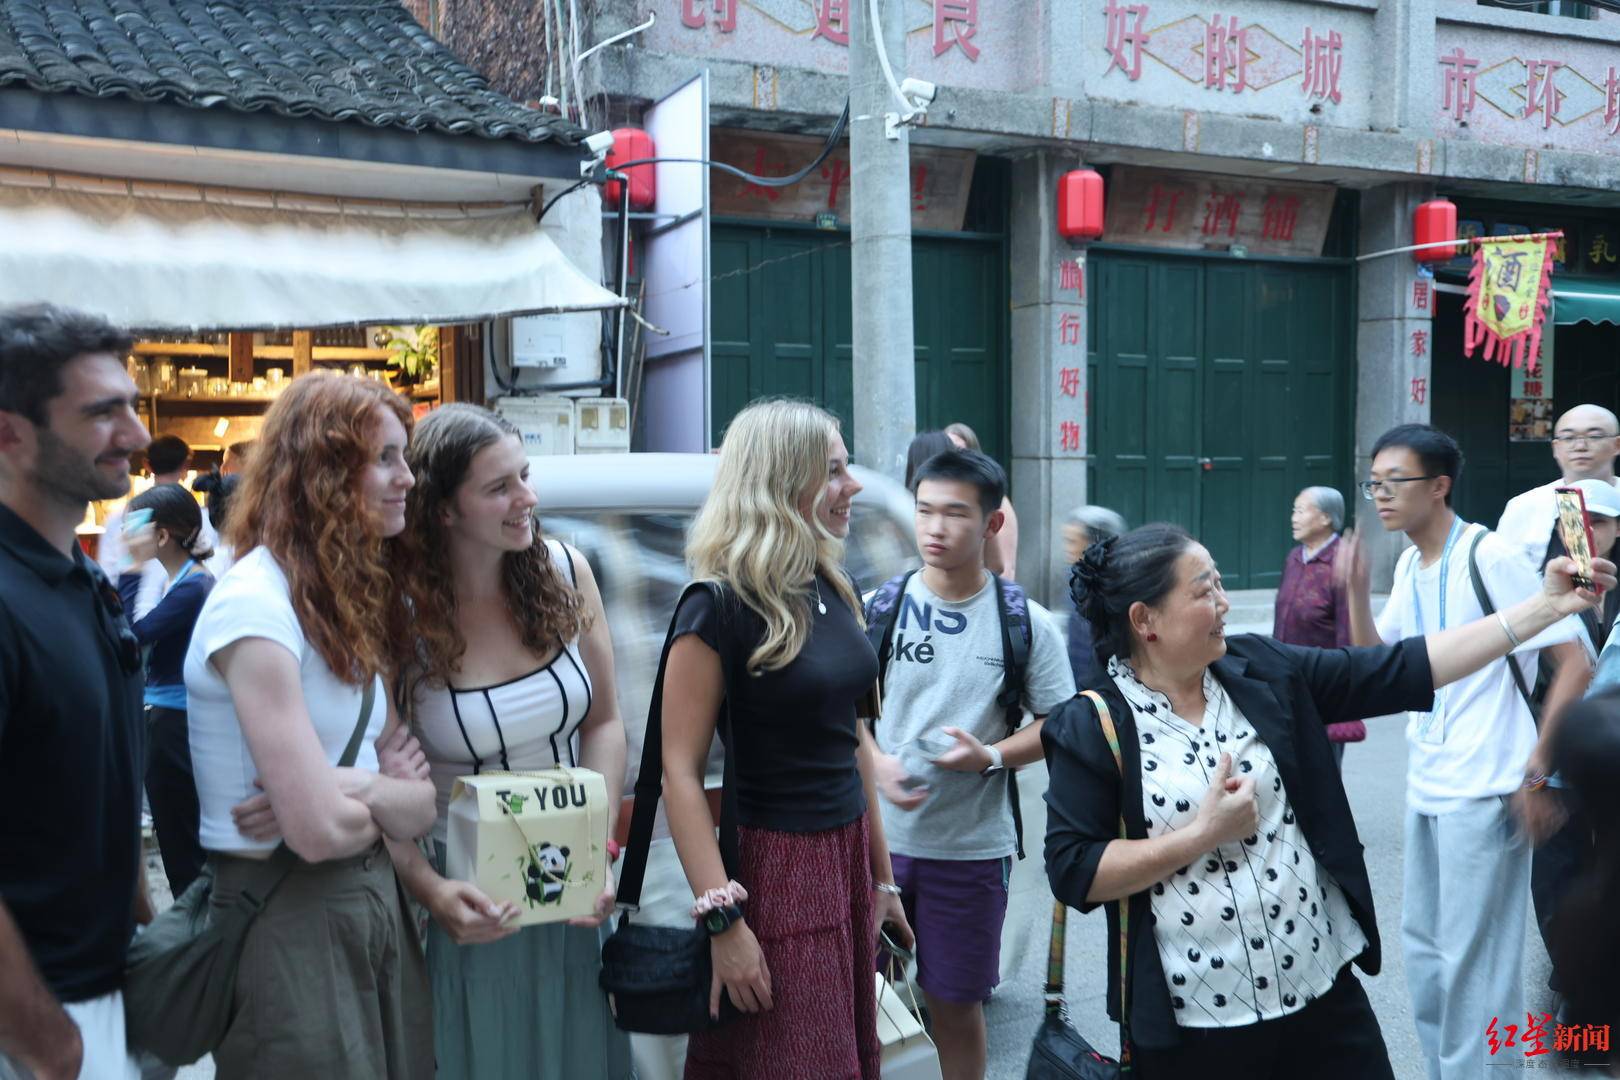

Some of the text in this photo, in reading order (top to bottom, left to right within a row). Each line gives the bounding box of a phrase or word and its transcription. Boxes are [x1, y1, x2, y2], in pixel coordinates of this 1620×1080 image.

[1411, 279, 1429, 405] 居家好
[534, 784, 587, 811] YOU
